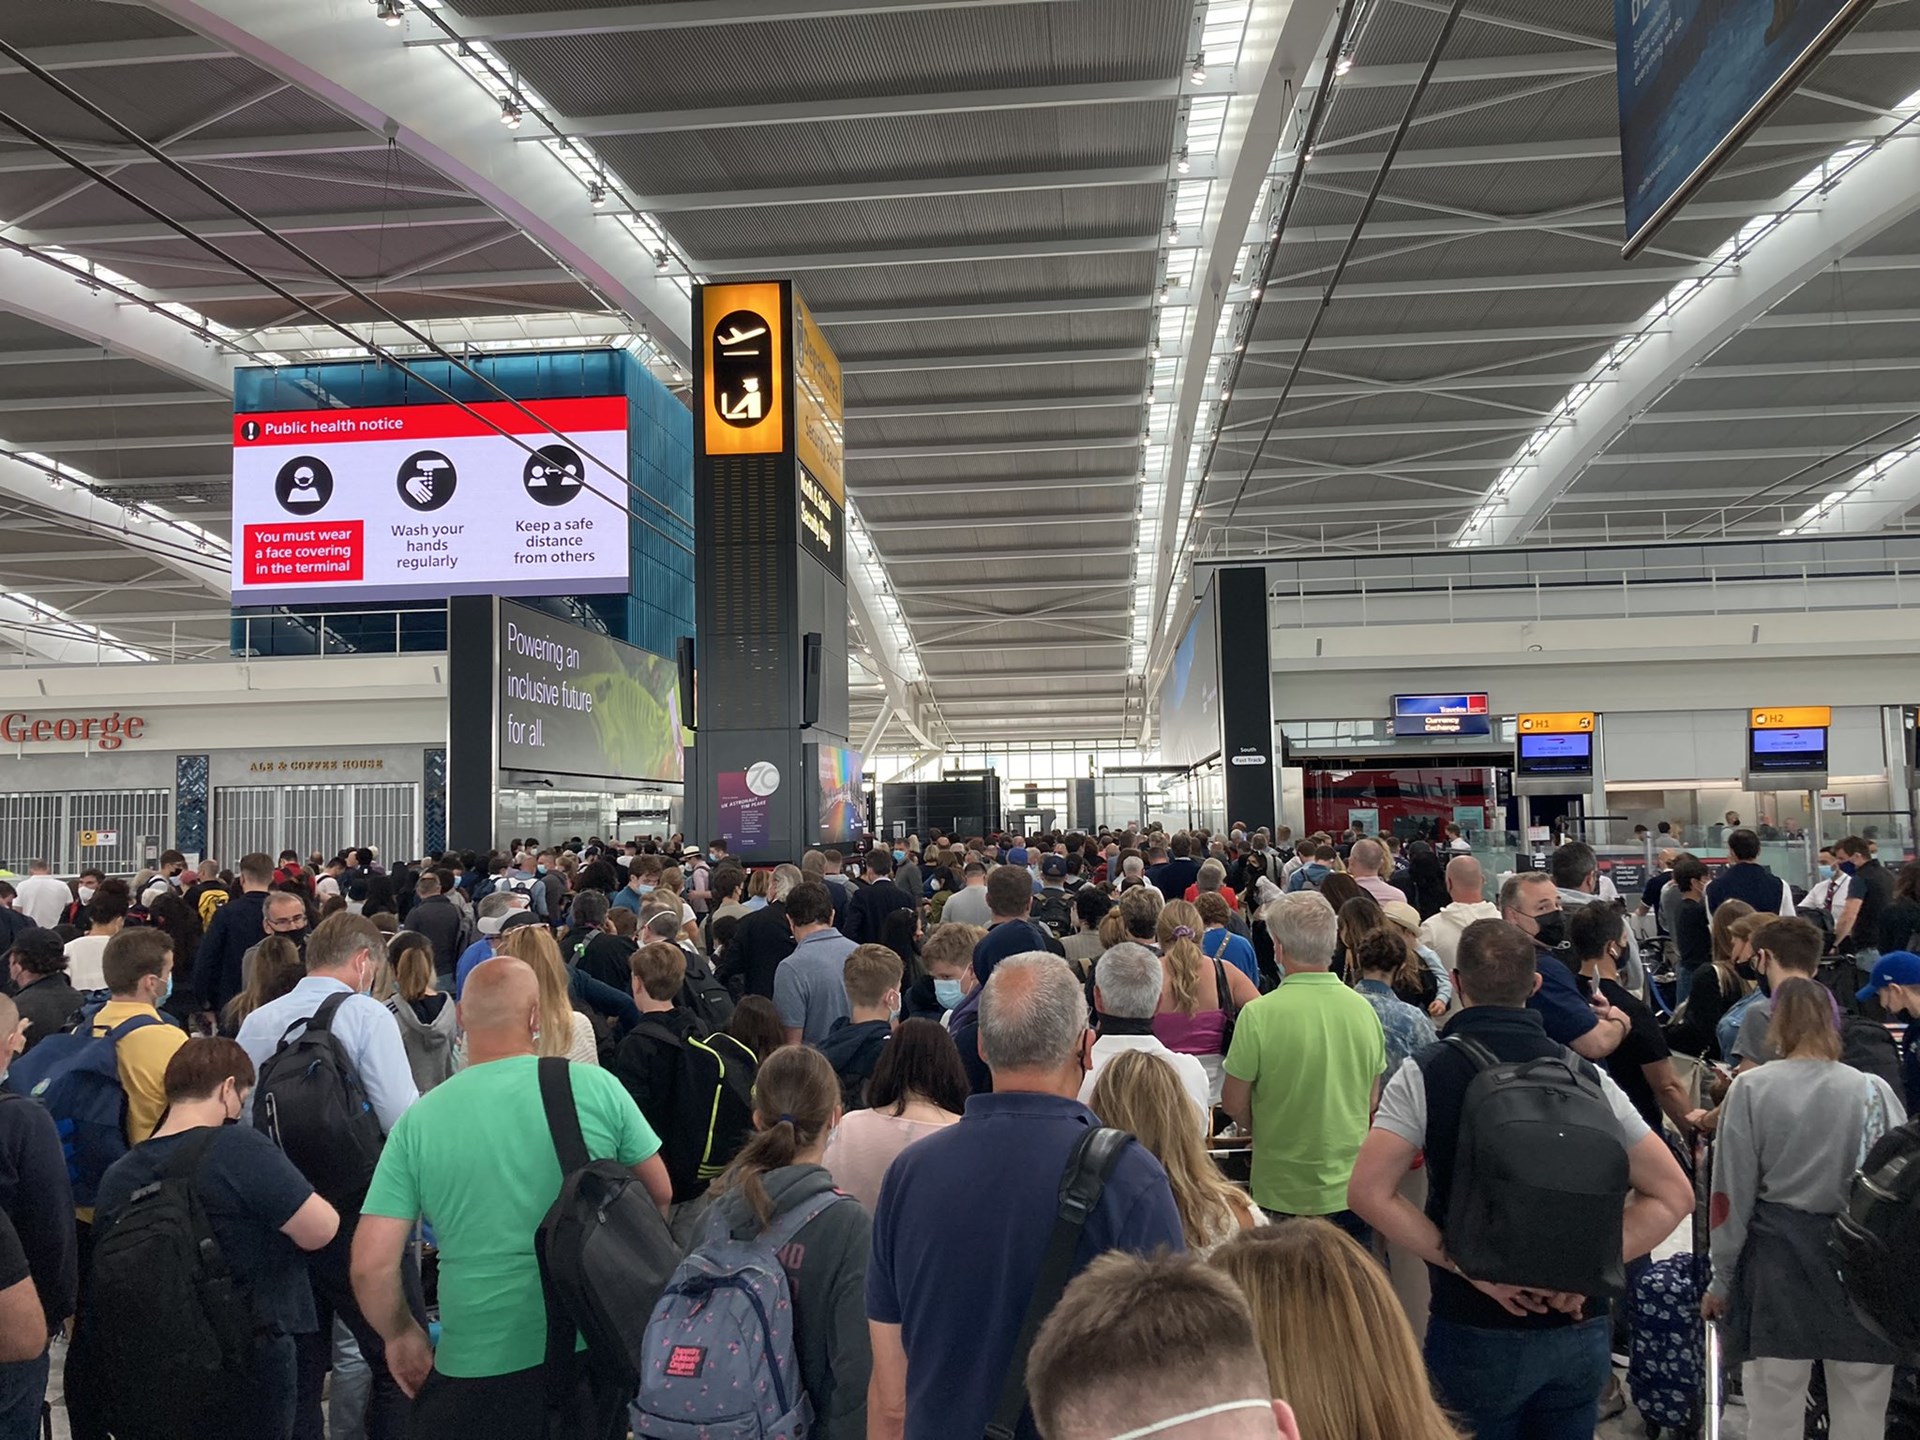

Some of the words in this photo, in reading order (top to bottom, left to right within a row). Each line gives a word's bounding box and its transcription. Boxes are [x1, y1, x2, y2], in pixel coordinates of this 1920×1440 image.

[804, 328, 839, 403] Departures
[265, 421, 307, 435] Public
[310, 419, 356, 433] health
[359, 417, 404, 431] notice
[391, 523, 429, 536] Wash
[432, 524, 464, 538] your
[515, 520, 551, 534] Keep
[553, 521, 562, 531] a
[565, 517, 593, 530] safe
[255, 532, 280, 543] You
[283, 530, 316, 542] must
[318, 530, 352, 541] wear
[525, 535, 583, 548] distance
[255, 549, 263, 559] a
[265, 546, 292, 558] face
[295, 544, 351, 558] covering
[406, 539, 448, 552] hands
[396, 554, 459, 571] regularly
[514, 551, 547, 564] from
[550, 550, 595, 563] others
[256, 562, 268, 575] in
[271, 562, 293, 574] the
[295, 560, 350, 573] terminal
[508, 622, 563, 671] Powering
[566, 647, 580, 670] an
[508, 667, 559, 706] inclusive
[562, 680, 592, 713] future
[1424, 716, 1460, 725] Currency
[1535, 719, 1549, 728] H1
[1769, 714, 1784, 723] H2
[0, 712, 145, 750] George
[507, 713, 526, 744] for
[528, 718, 545, 747] all.
[1424, 724, 1461, 732] Exchange
[250, 761, 274, 772] ALE
[278, 761, 288, 771] &
[290, 760, 338, 771] COFFEE
[342, 759, 383, 770] HOUSE
